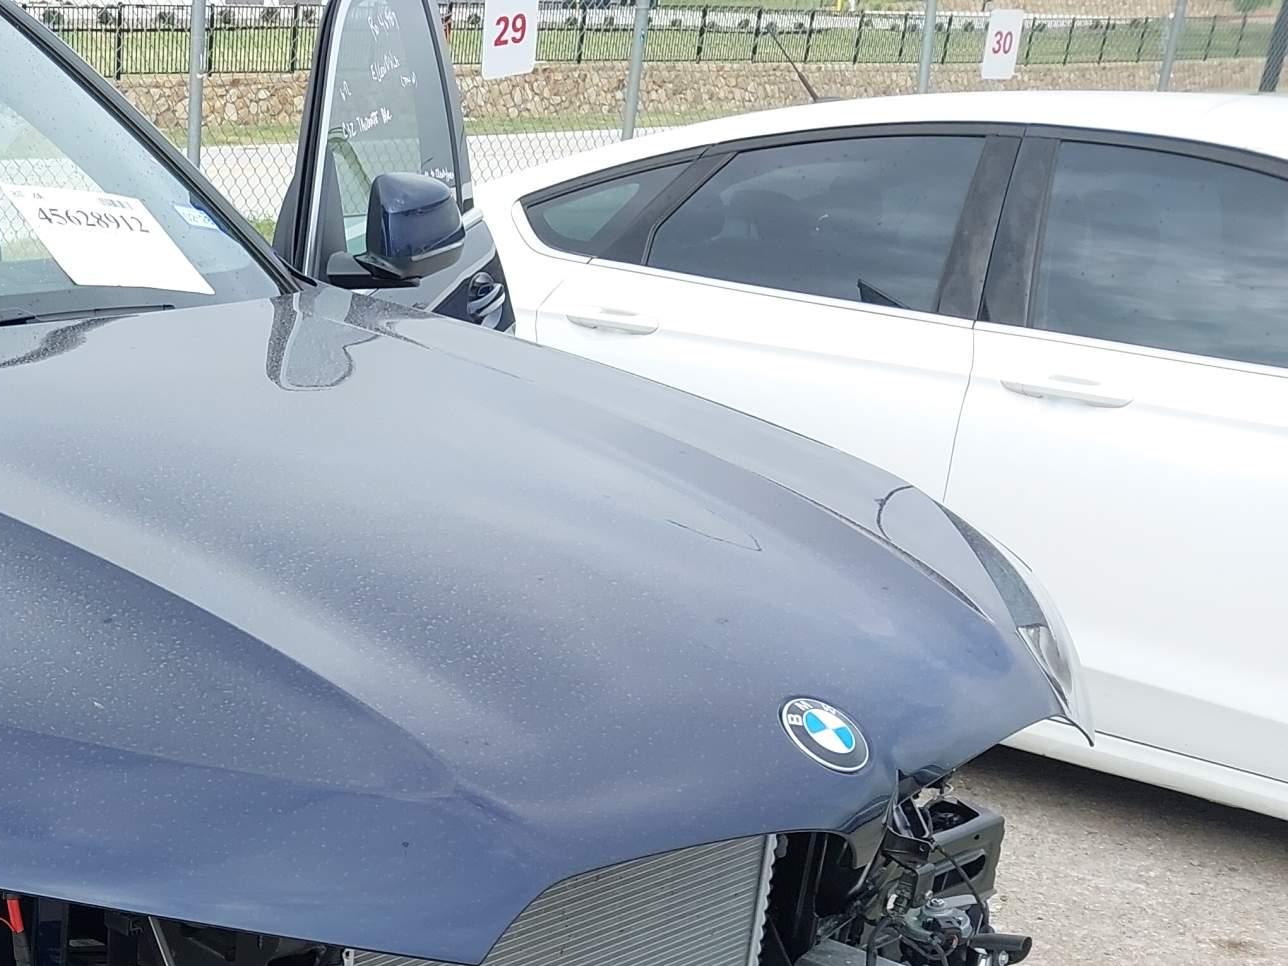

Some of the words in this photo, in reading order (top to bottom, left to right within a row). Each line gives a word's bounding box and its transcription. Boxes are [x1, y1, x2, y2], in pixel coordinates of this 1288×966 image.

[493, 13, 528, 47] 29
[991, 30, 1014, 55] 30
[37, 207, 151, 234] 45628912
[787, 700, 838, 727] BMW
